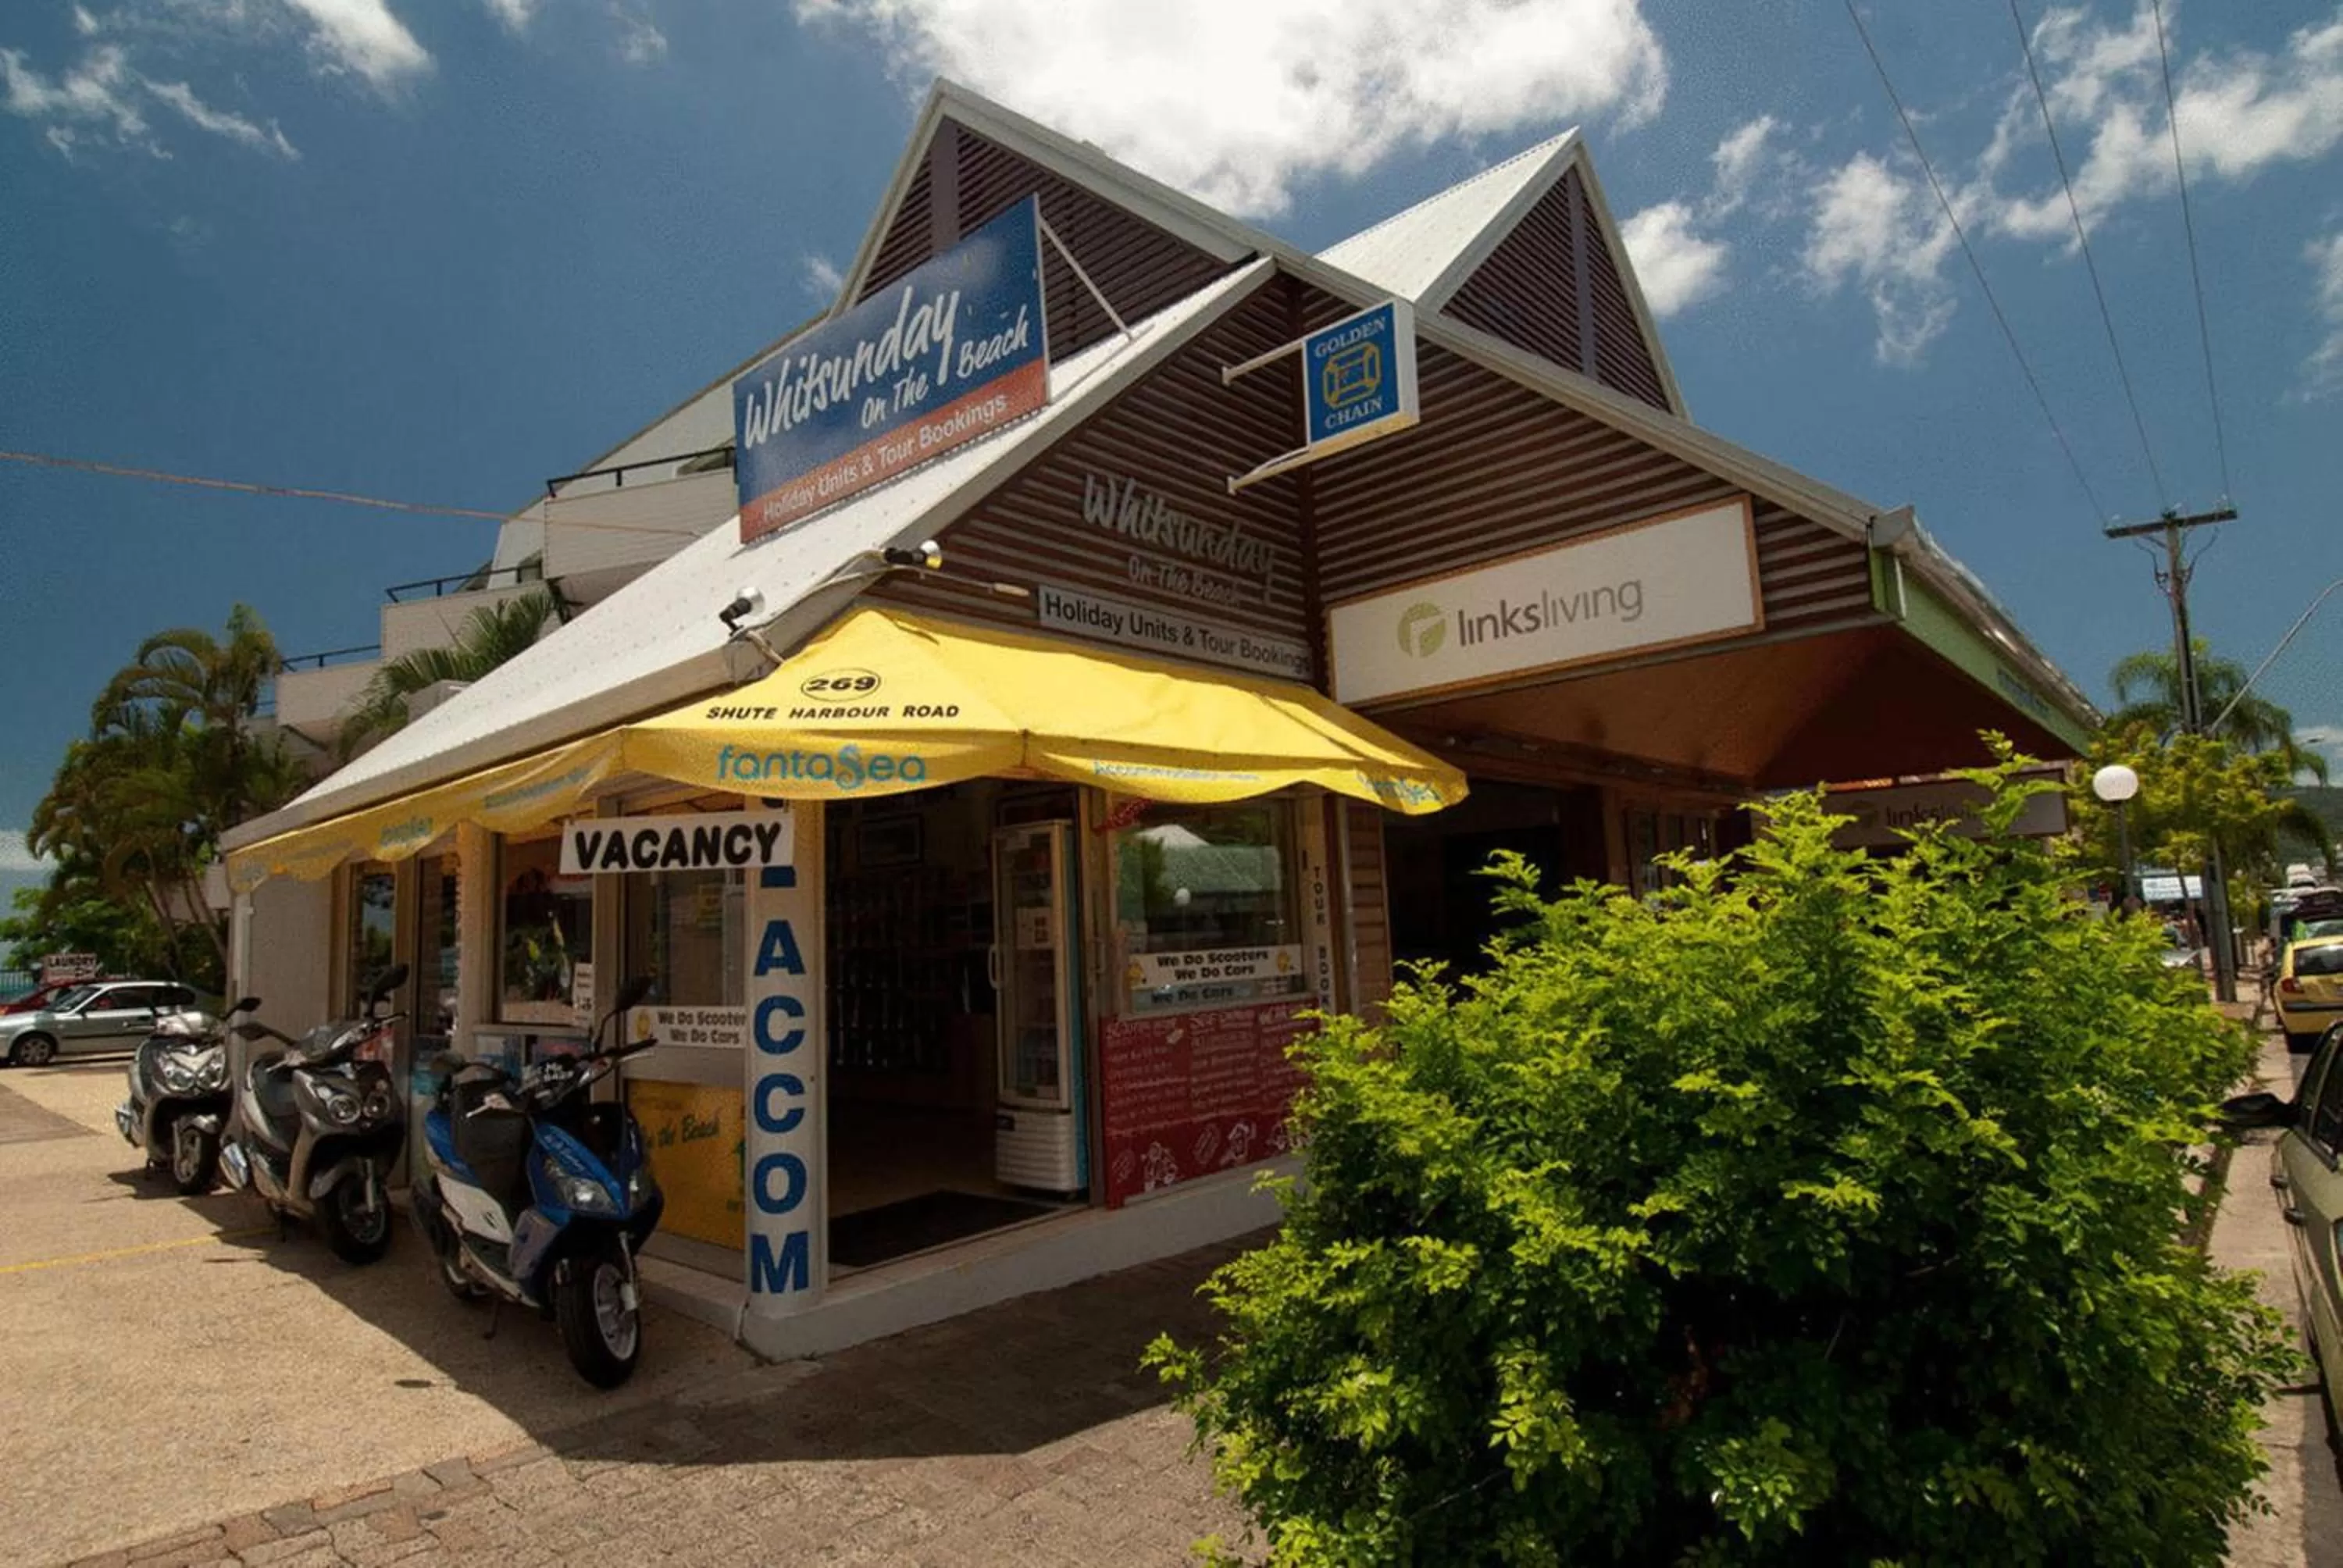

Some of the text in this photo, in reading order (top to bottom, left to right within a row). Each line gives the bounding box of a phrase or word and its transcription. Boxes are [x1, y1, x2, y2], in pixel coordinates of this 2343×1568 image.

[1314, 315, 1387, 358] GOLDEN
[744, 286, 959, 450] Whitsunday
[862, 304, 1029, 429] On The Beach
[1325, 396, 1383, 429] CHAIN
[762, 393, 1008, 522] Holiday Units & Tour Bookings
[1082, 472, 1278, 605] Whitsunday
[1044, 592, 1311, 675] Holiday Units & Tour Bookings
[1457, 579, 1644, 647] linksliving
[805, 676, 876, 692] 269
[706, 704, 960, 720] SHUTE HARBOUR ROAD
[717, 742, 926, 790] fantaSea
[575, 822, 782, 870] VACANCY
[1314, 866, 1325, 925] TOUR
[1157, 950, 1269, 968] We Do Scooters
[1174, 964, 1256, 981] We Do Cars
[658, 1011, 675, 1025] We
[676, 1011, 694, 1025] Do
[669, 1028, 740, 1045] We Do Cars
[751, 919, 809, 1294] ACCOM
